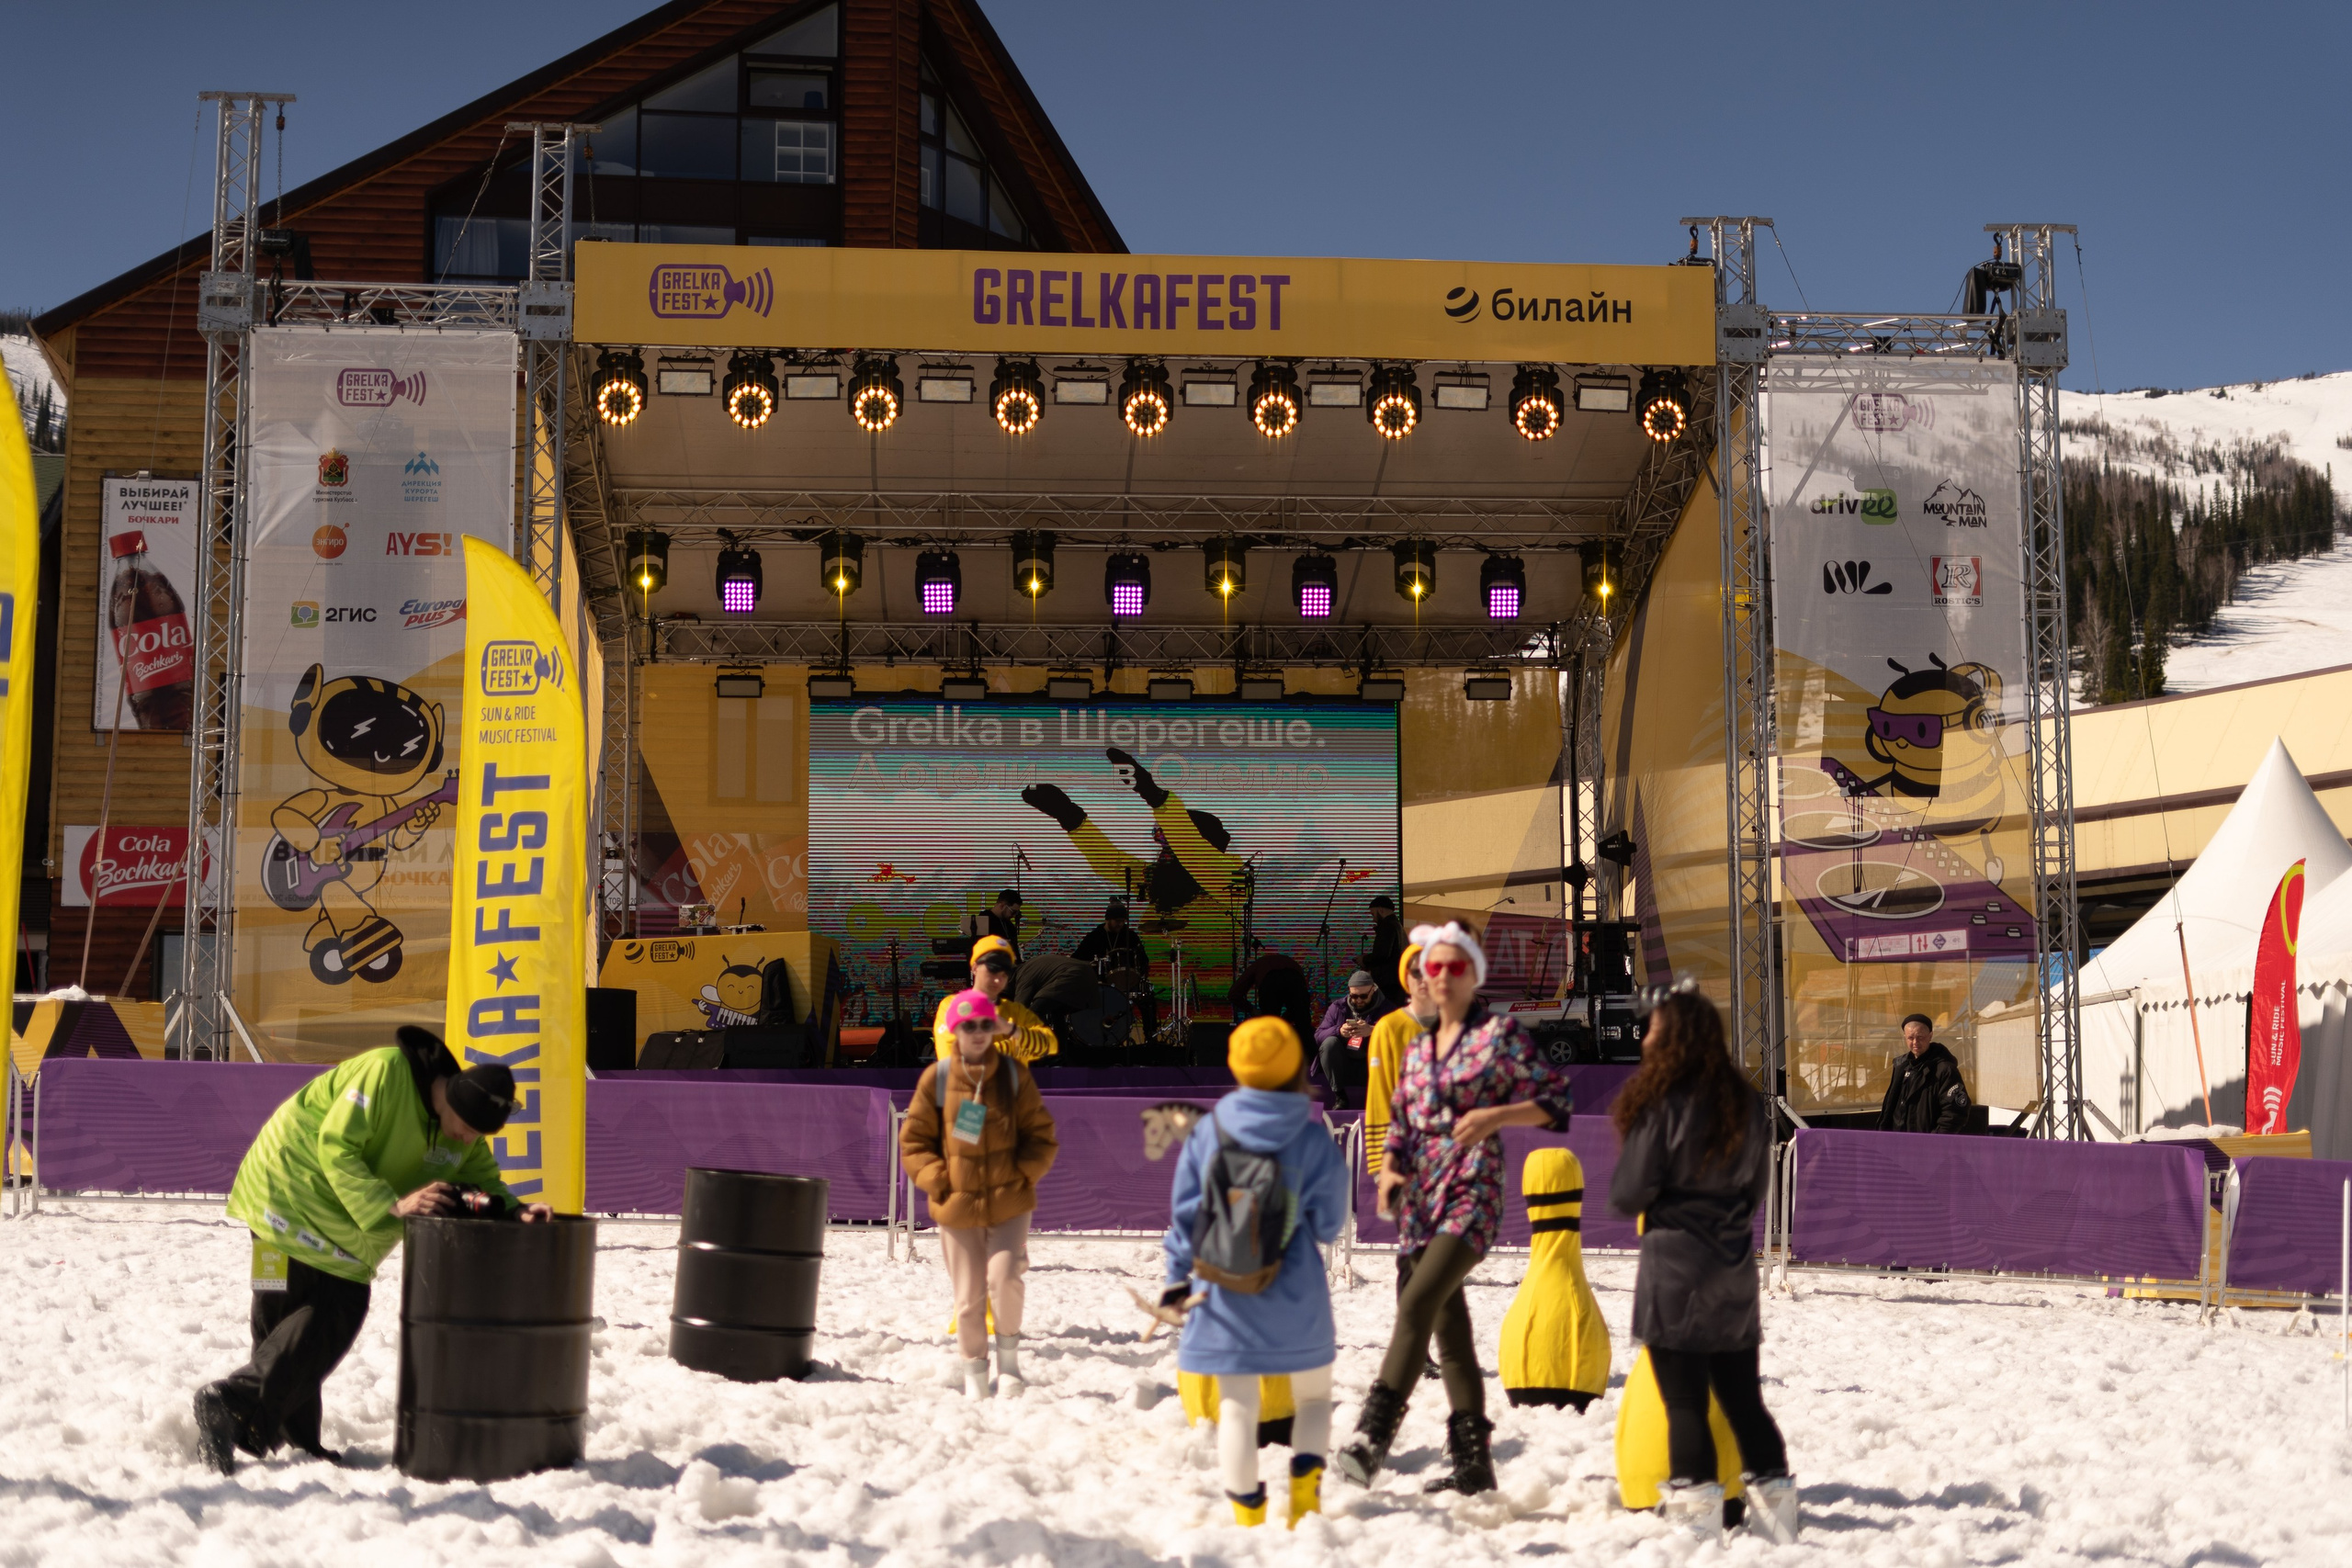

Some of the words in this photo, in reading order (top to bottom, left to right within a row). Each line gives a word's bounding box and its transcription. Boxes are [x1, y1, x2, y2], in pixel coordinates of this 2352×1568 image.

[662, 272, 720, 290] GRELKA
[662, 292, 702, 310] FEST
[974, 267, 1291, 331] GRELKAFEST
[1491, 288, 1632, 323] билайн
[345, 374, 389, 387] GRELKA
[345, 389, 375, 401] FEST
[1860, 399, 1900, 412] GRELKA
[1860, 413, 1888, 425] FEST
[119, 486, 189, 500] ВЫБИРАЙ
[401, 480, 442, 489] ДИРЕКЦИЯ
[1809, 492, 1898, 519] drivee
[128, 515, 179, 525] БОЧКАРИ
[1959, 516, 1987, 528] MAN
[315, 537, 345, 547] энгиро
[385, 532, 453, 556] AYS!
[399, 598, 462, 615] Europa
[1934, 597, 1981, 605] ROSTIC'S
[325, 607, 378, 623] 2ГИС
[119, 622, 187, 660] Cola
[132, 650, 182, 677] Bochkari
[491, 649, 534, 667] GRELKA
[490, 669, 521, 688] FEST
[481, 706, 503, 722] SUN
[503, 707, 513, 721] &
[514, 705, 537, 720] RIDE
[479, 728, 513, 745] MUSIC
[514, 727, 558, 743] FESTIVAL
[849, 705, 1003, 746] Grelka
[1019, 717, 1045, 746] в
[1059, 707, 1327, 756] Шерегеше.
[897, 761, 1037, 791] отели
[1112, 762, 1136, 792] в
[1150, 751, 1330, 792] Отелло
[118, 835, 171, 852] Cola
[474, 761, 551, 947] FEST
[662, 833, 734, 908] Cola
[654, 943, 676, 952] GRELKA
[654, 952, 670, 960] FEST
[2271, 1004, 2280, 1031] RIDE
[2276, 1031, 2285, 1066] MUSIC
